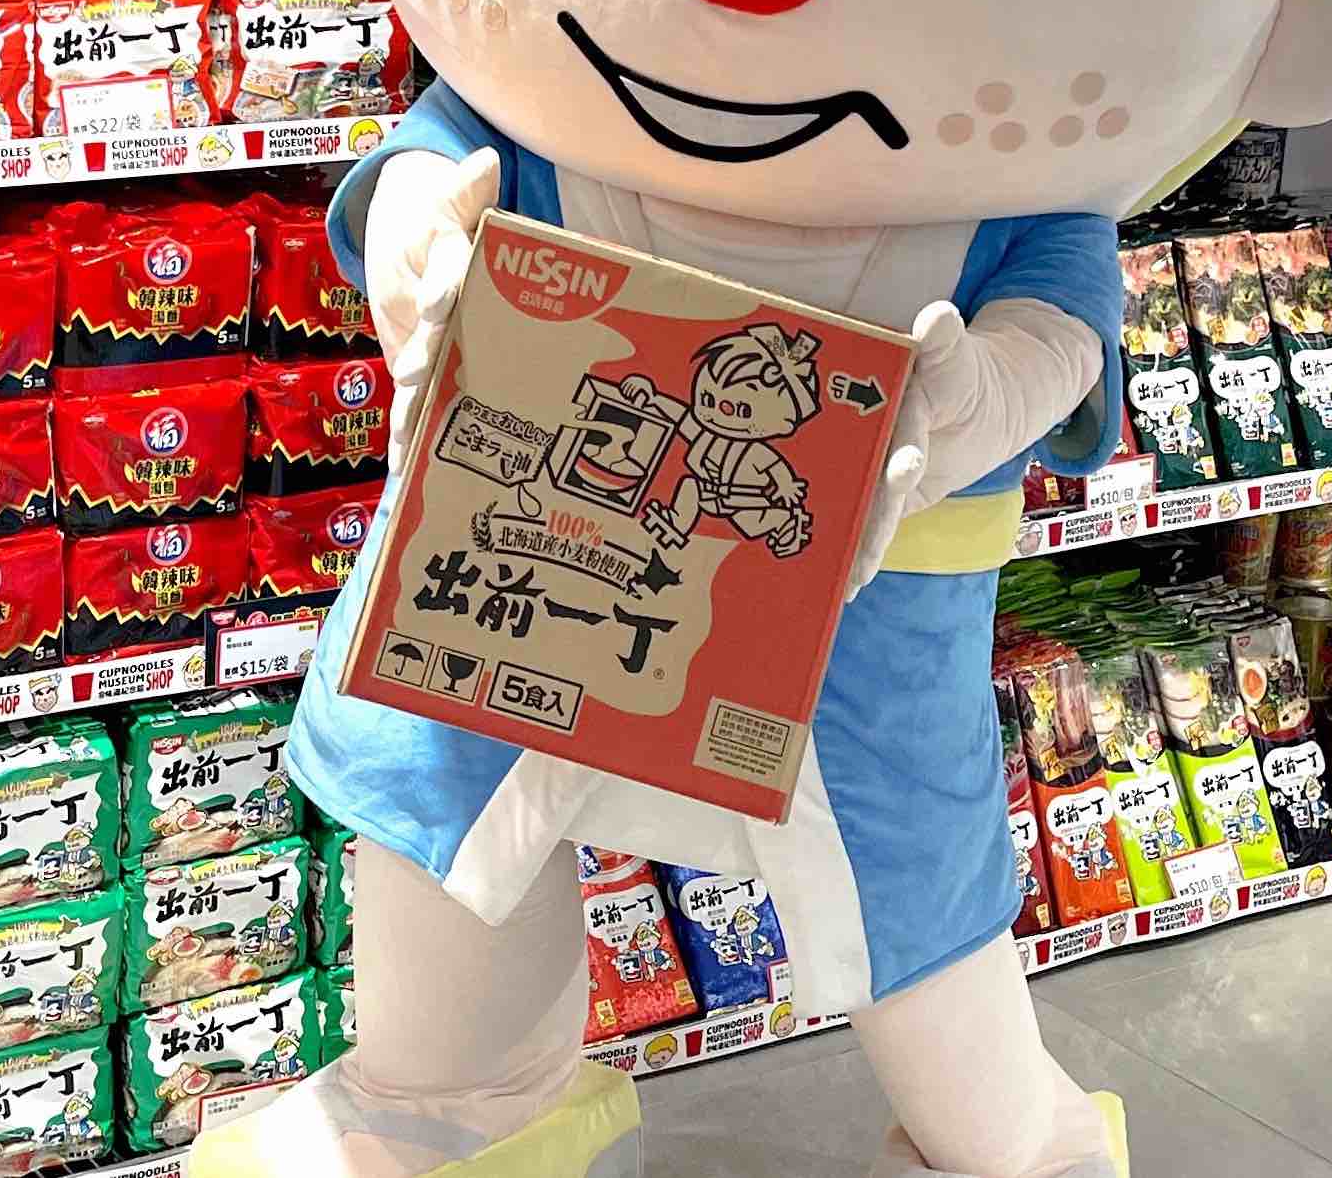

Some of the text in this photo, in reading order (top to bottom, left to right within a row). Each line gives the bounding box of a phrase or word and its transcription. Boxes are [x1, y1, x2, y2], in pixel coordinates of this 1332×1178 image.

[53, 24, 187, 66] 出前一丁
[246, 13, 379, 51] 出前一丁
[268, 125, 341, 140] CUPNOODLES
[314, 133, 340, 155] SHOP
[152, 243, 183, 282] 福
[493, 243, 609, 301] NISSIN
[829, 373, 846, 400] UP
[1138, 379, 1191, 400] 出前一丁
[1219, 365, 1271, 388] 出前一丁
[547, 509, 605, 547] 100%
[498, 525, 631, 583] 北海道産小麦粉使用
[413, 550, 678, 675] 出前一丁
[99, 658, 174, 679] CUPNOODLES
[146, 667, 174, 691] SHOP
[240, 654, 289, 677] $15/袋
[501, 677, 566, 718] 5食入
[162, 739, 285, 796] 出前一丁
[1201, 766, 1254, 797] 出前一丁
[1272, 753, 1318, 778] 出前一丁
[1119, 780, 1170, 811] 出前一丁
[1053, 799, 1104, 826] 出前一丁
[156, 868, 287, 924] 出前一丁
[590, 894, 655, 928] 出前一丁
[689, 879, 756, 912] 出前一丁
[162, 998, 291, 1062] 出前一丁
